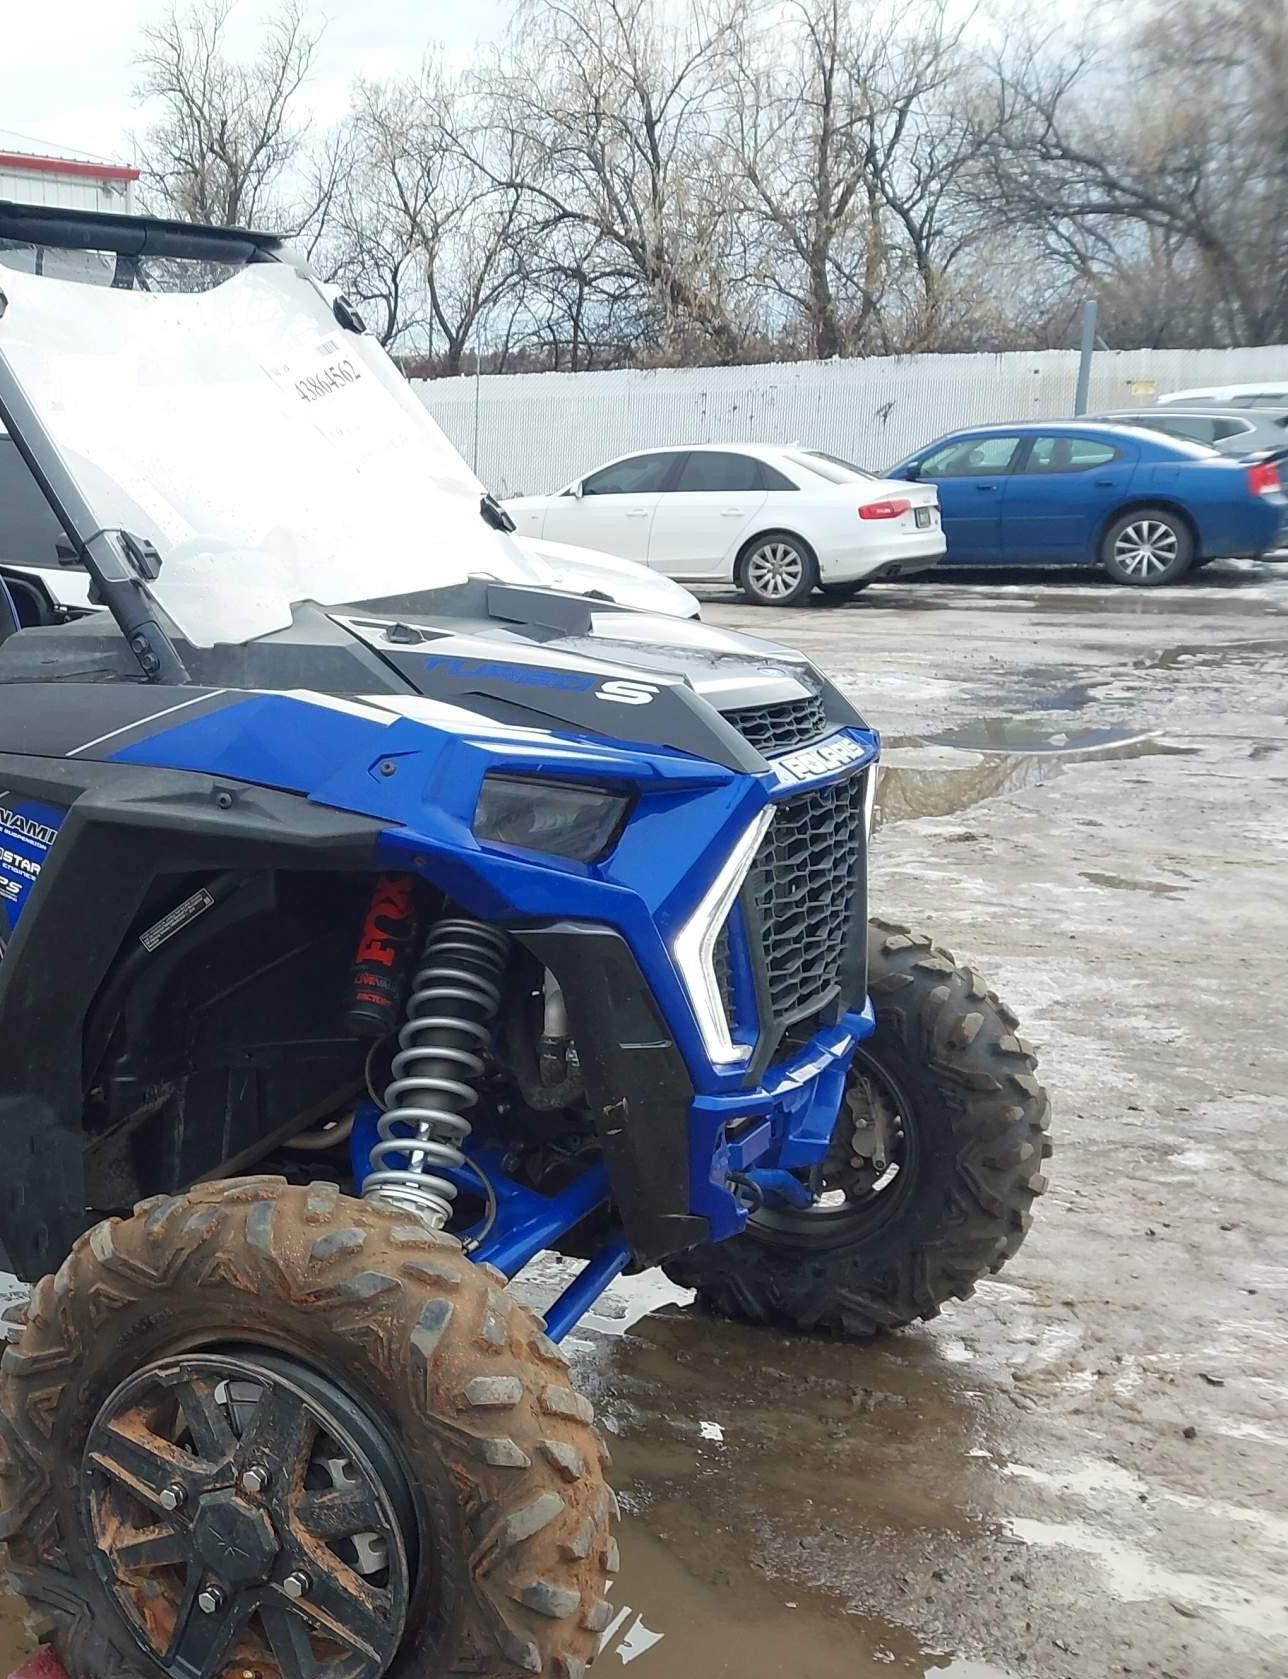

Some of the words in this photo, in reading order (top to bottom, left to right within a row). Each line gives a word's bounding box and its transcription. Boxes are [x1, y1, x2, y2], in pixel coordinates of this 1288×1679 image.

[295, 360, 361, 402] 43864562
[424, 656, 598, 693] TURBO
[594, 680, 660, 705] S
[778, 736, 866, 781] POLARIS
[355, 876, 413, 967] FOX
